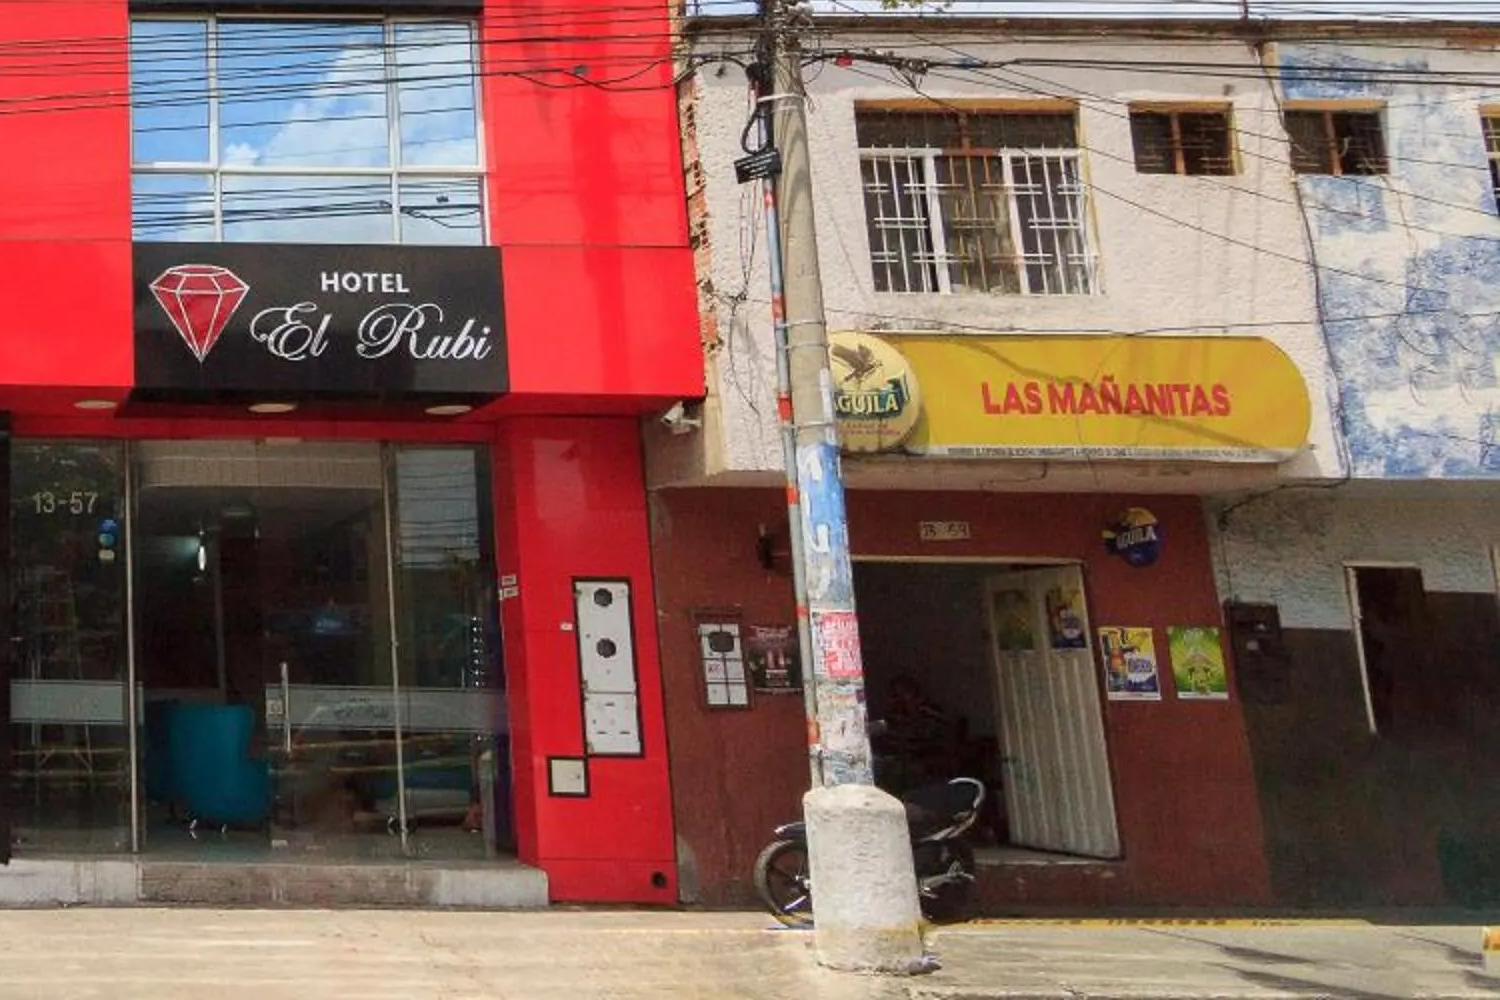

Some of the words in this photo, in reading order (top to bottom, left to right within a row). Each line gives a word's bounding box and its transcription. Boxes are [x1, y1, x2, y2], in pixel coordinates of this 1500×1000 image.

[320, 271, 410, 293] HOTEL
[250, 301, 333, 361] El
[356, 303, 491, 359] Rubi
[833, 391, 899, 414] GUILA
[981, 382, 1043, 415] LAS
[1046, 375, 1231, 416] MAÑANITAS
[32, 491, 99, 515] 13-57
